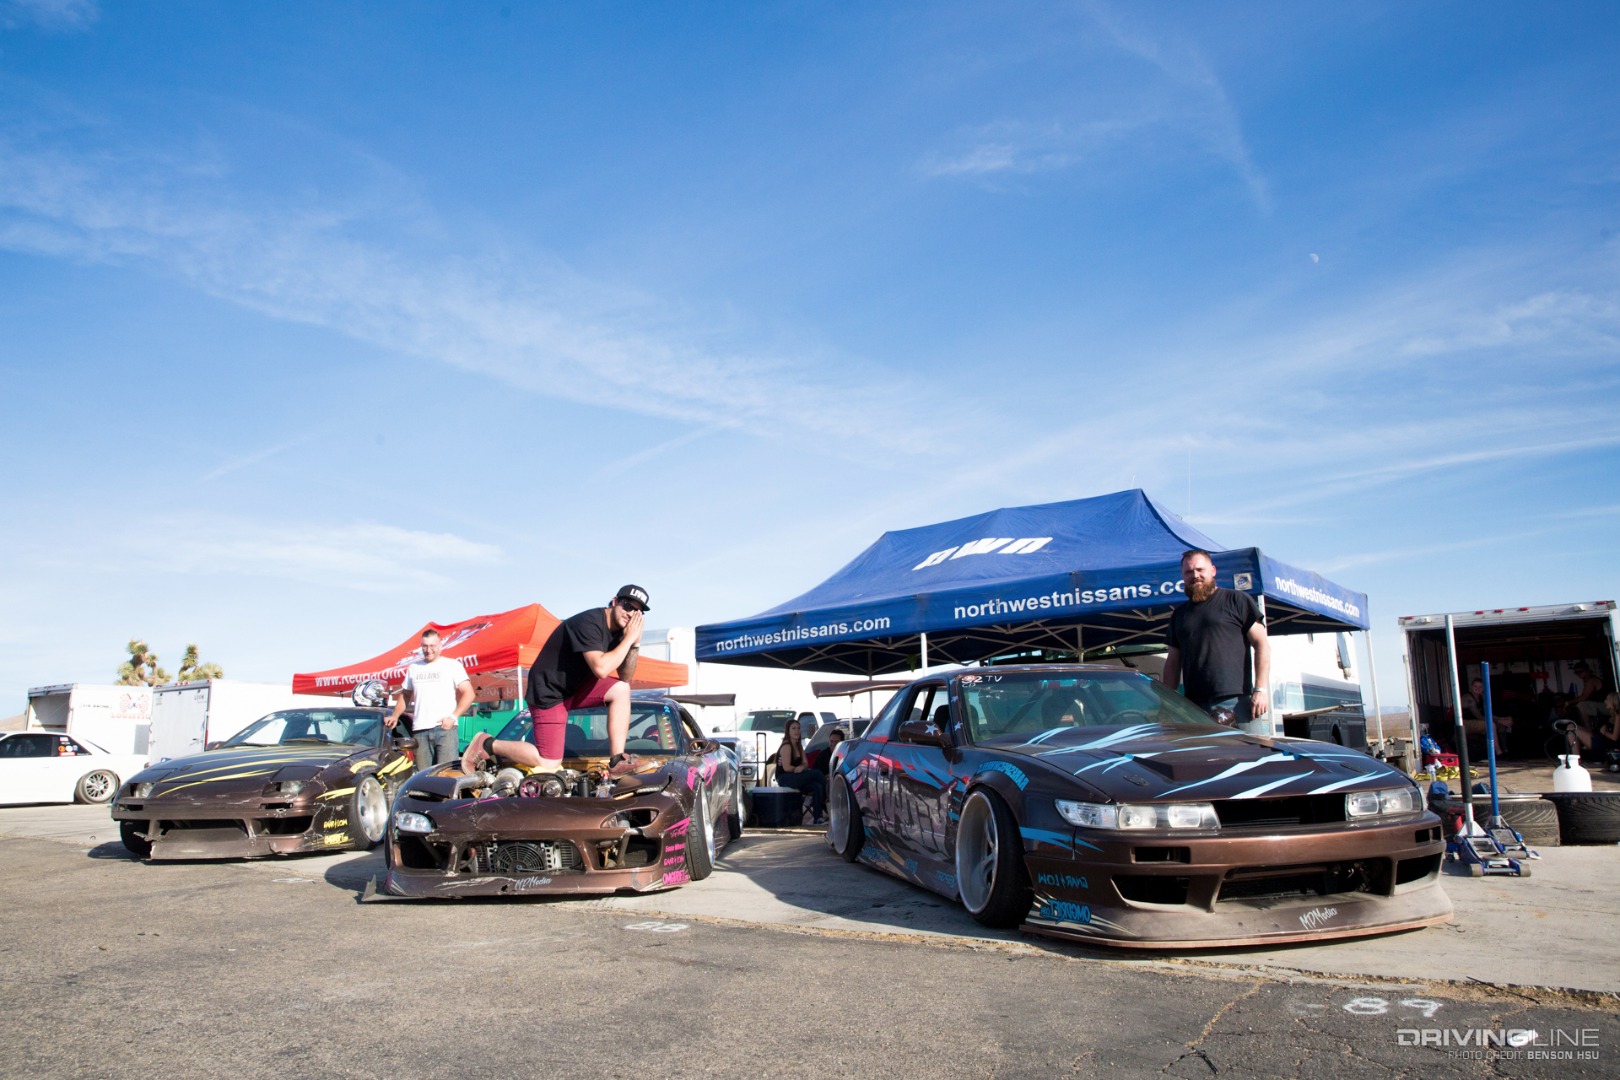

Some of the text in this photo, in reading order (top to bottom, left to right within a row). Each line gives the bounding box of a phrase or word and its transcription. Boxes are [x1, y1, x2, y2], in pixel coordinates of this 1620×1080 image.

[954, 579, 1186, 619] northwestnissans.co
[1275, 576, 1360, 618] northwestnissans.com
[716, 616, 891, 652] northwestnissans.com
